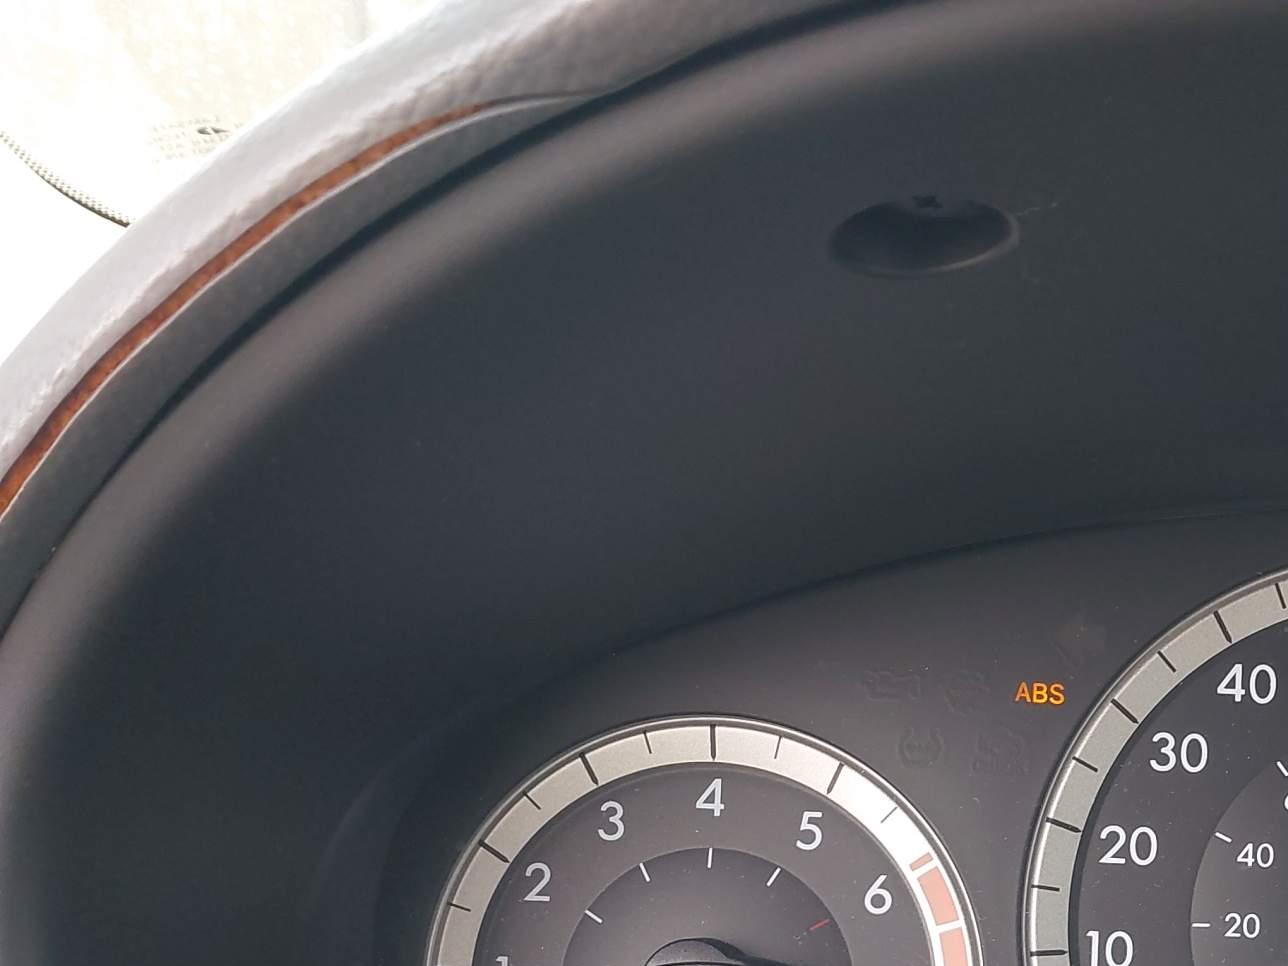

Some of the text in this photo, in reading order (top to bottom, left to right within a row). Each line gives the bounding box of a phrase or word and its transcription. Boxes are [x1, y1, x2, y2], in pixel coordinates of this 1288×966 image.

[1016, 682, 1064, 704] ABS
[1217, 664, 1276, 704] 40
[1150, 732, 1207, 772] 30
[696, 779, 724, 816] 4
[598, 801, 624, 840] 3
[797, 812, 822, 850] 5
[1099, 826, 1157, 865] 20
[1237, 842, 1274, 867] 40
[524, 863, 550, 901] 2
[865, 875, 892, 914] 6
[1224, 913, 1260, 938] 20
